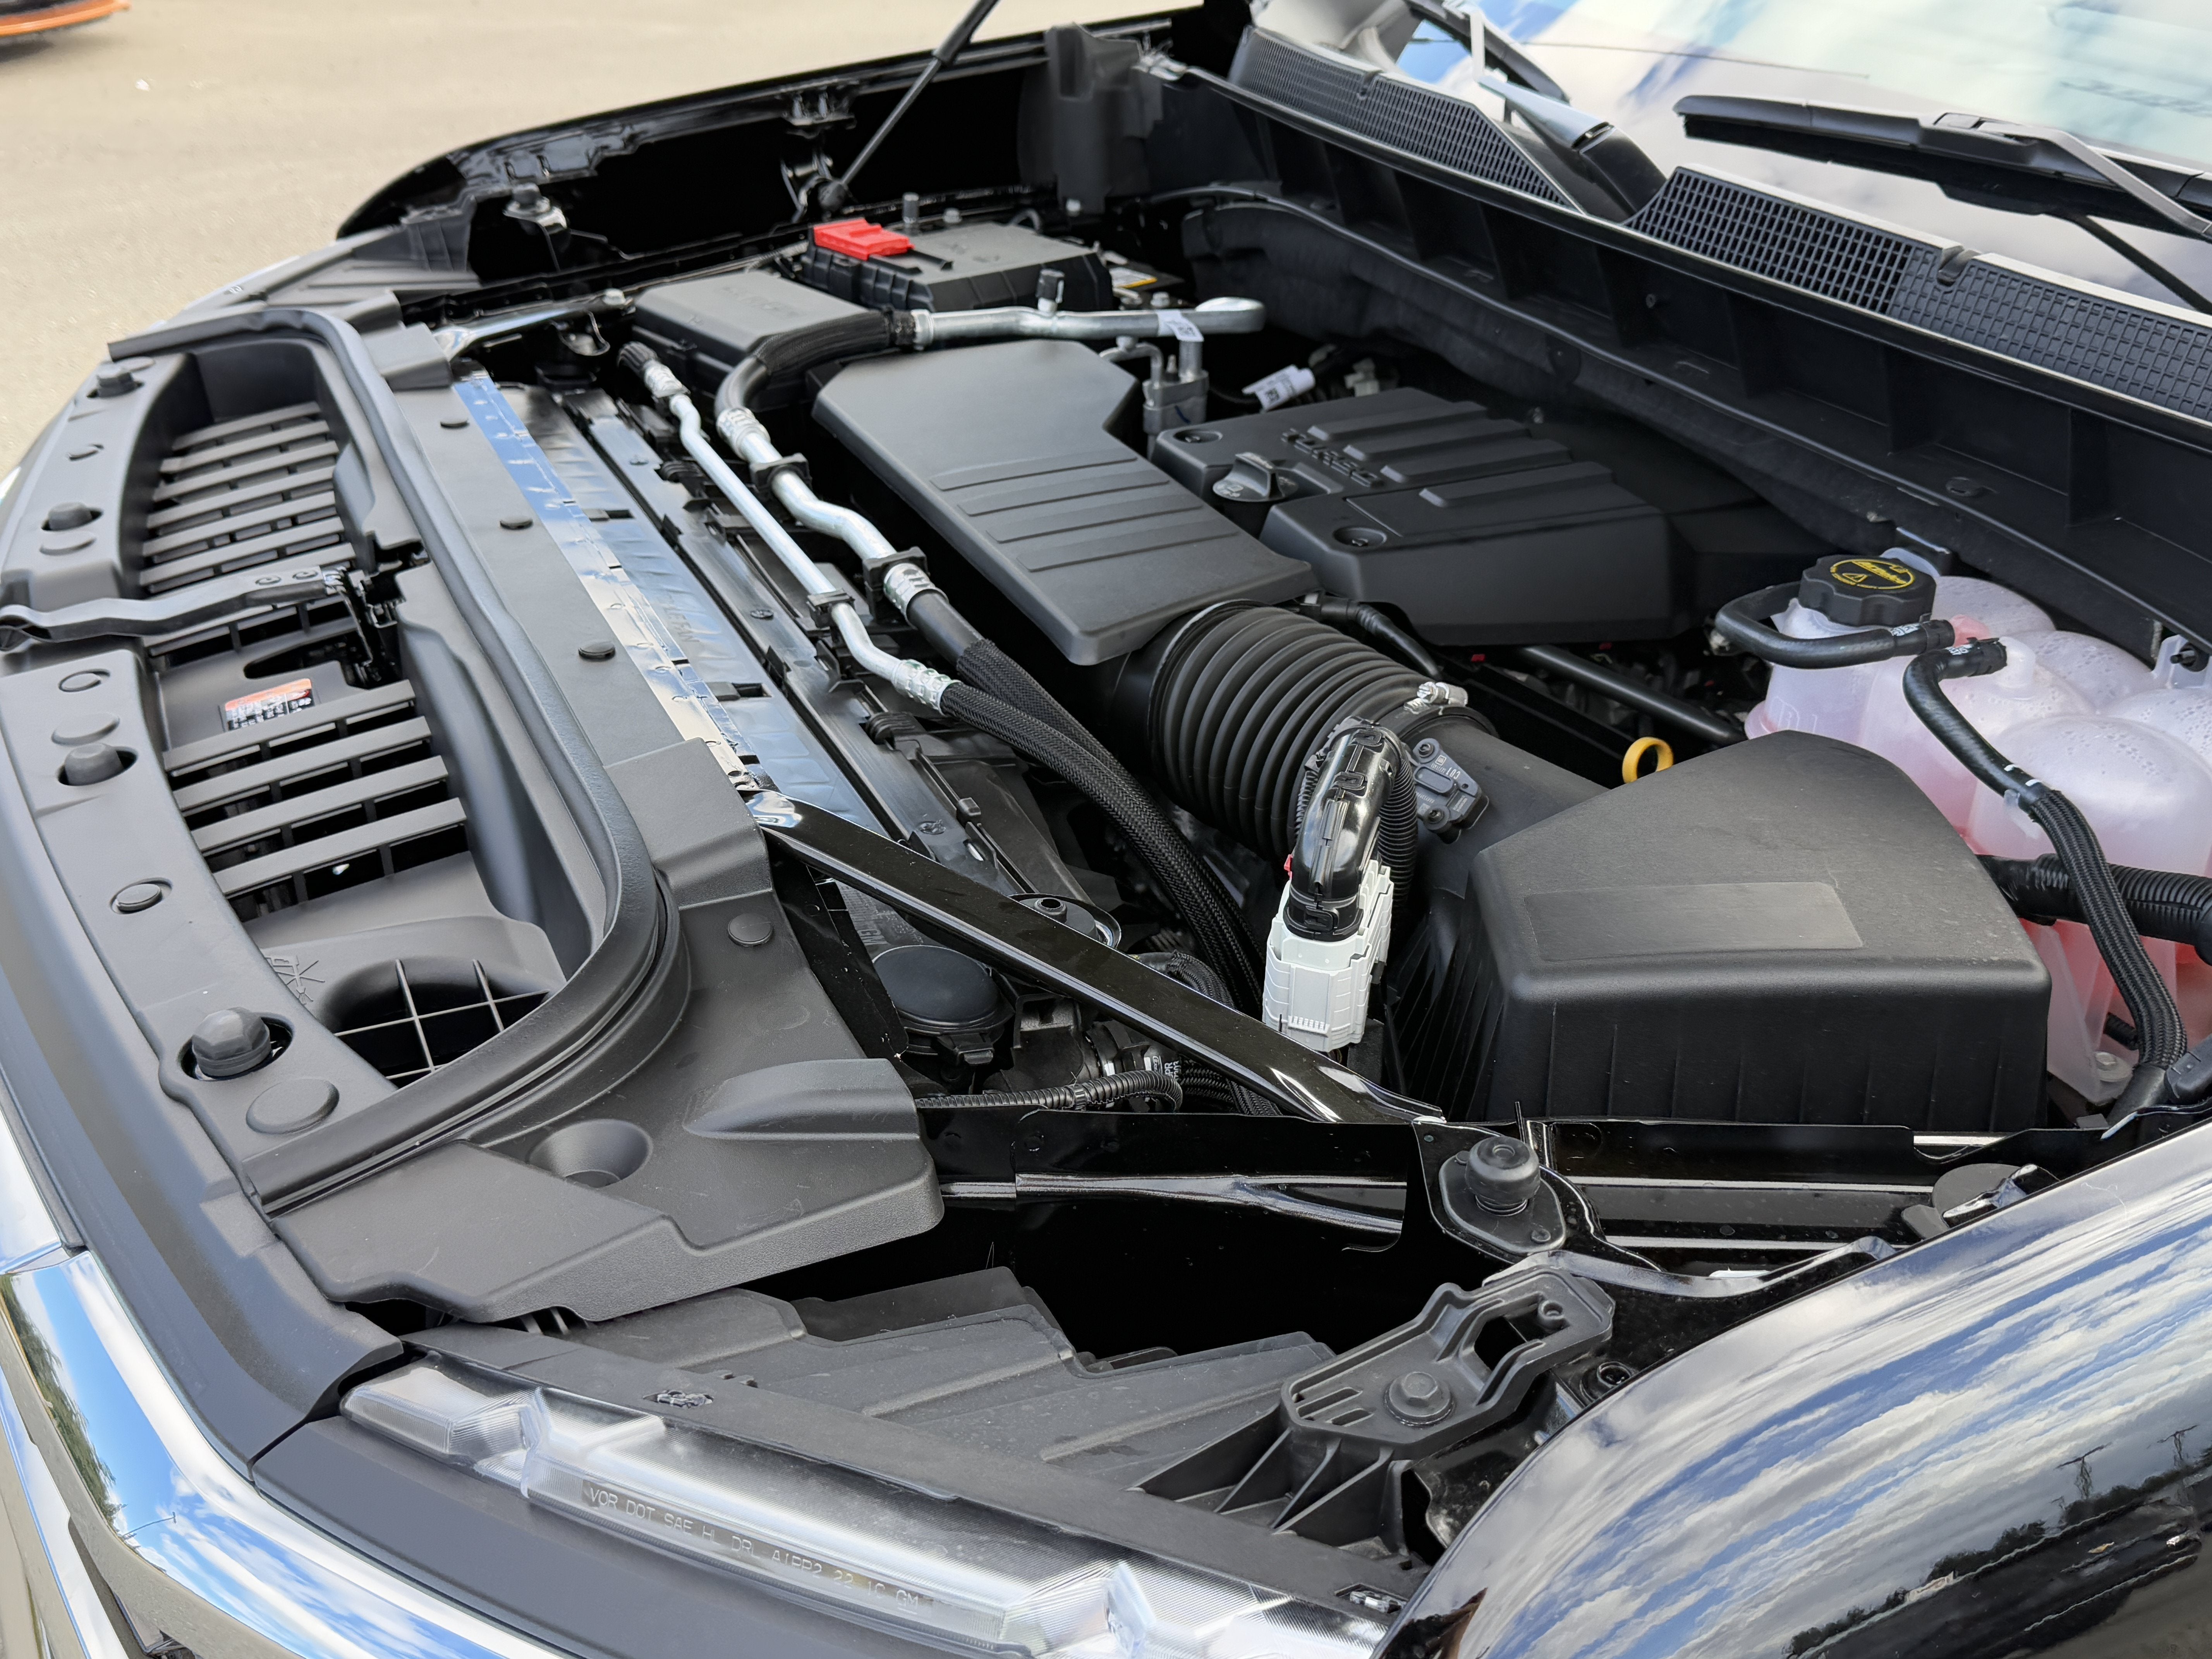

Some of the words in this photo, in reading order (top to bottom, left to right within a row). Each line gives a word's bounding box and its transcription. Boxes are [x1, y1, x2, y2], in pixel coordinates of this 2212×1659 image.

[590, 1487, 619, 1510] VOR
[626, 1499, 656, 1522] DOT
[664, 1513, 694, 1535] SAE
[732, 1535, 761, 1559] DRL
[896, 1589, 919, 1610] GM
